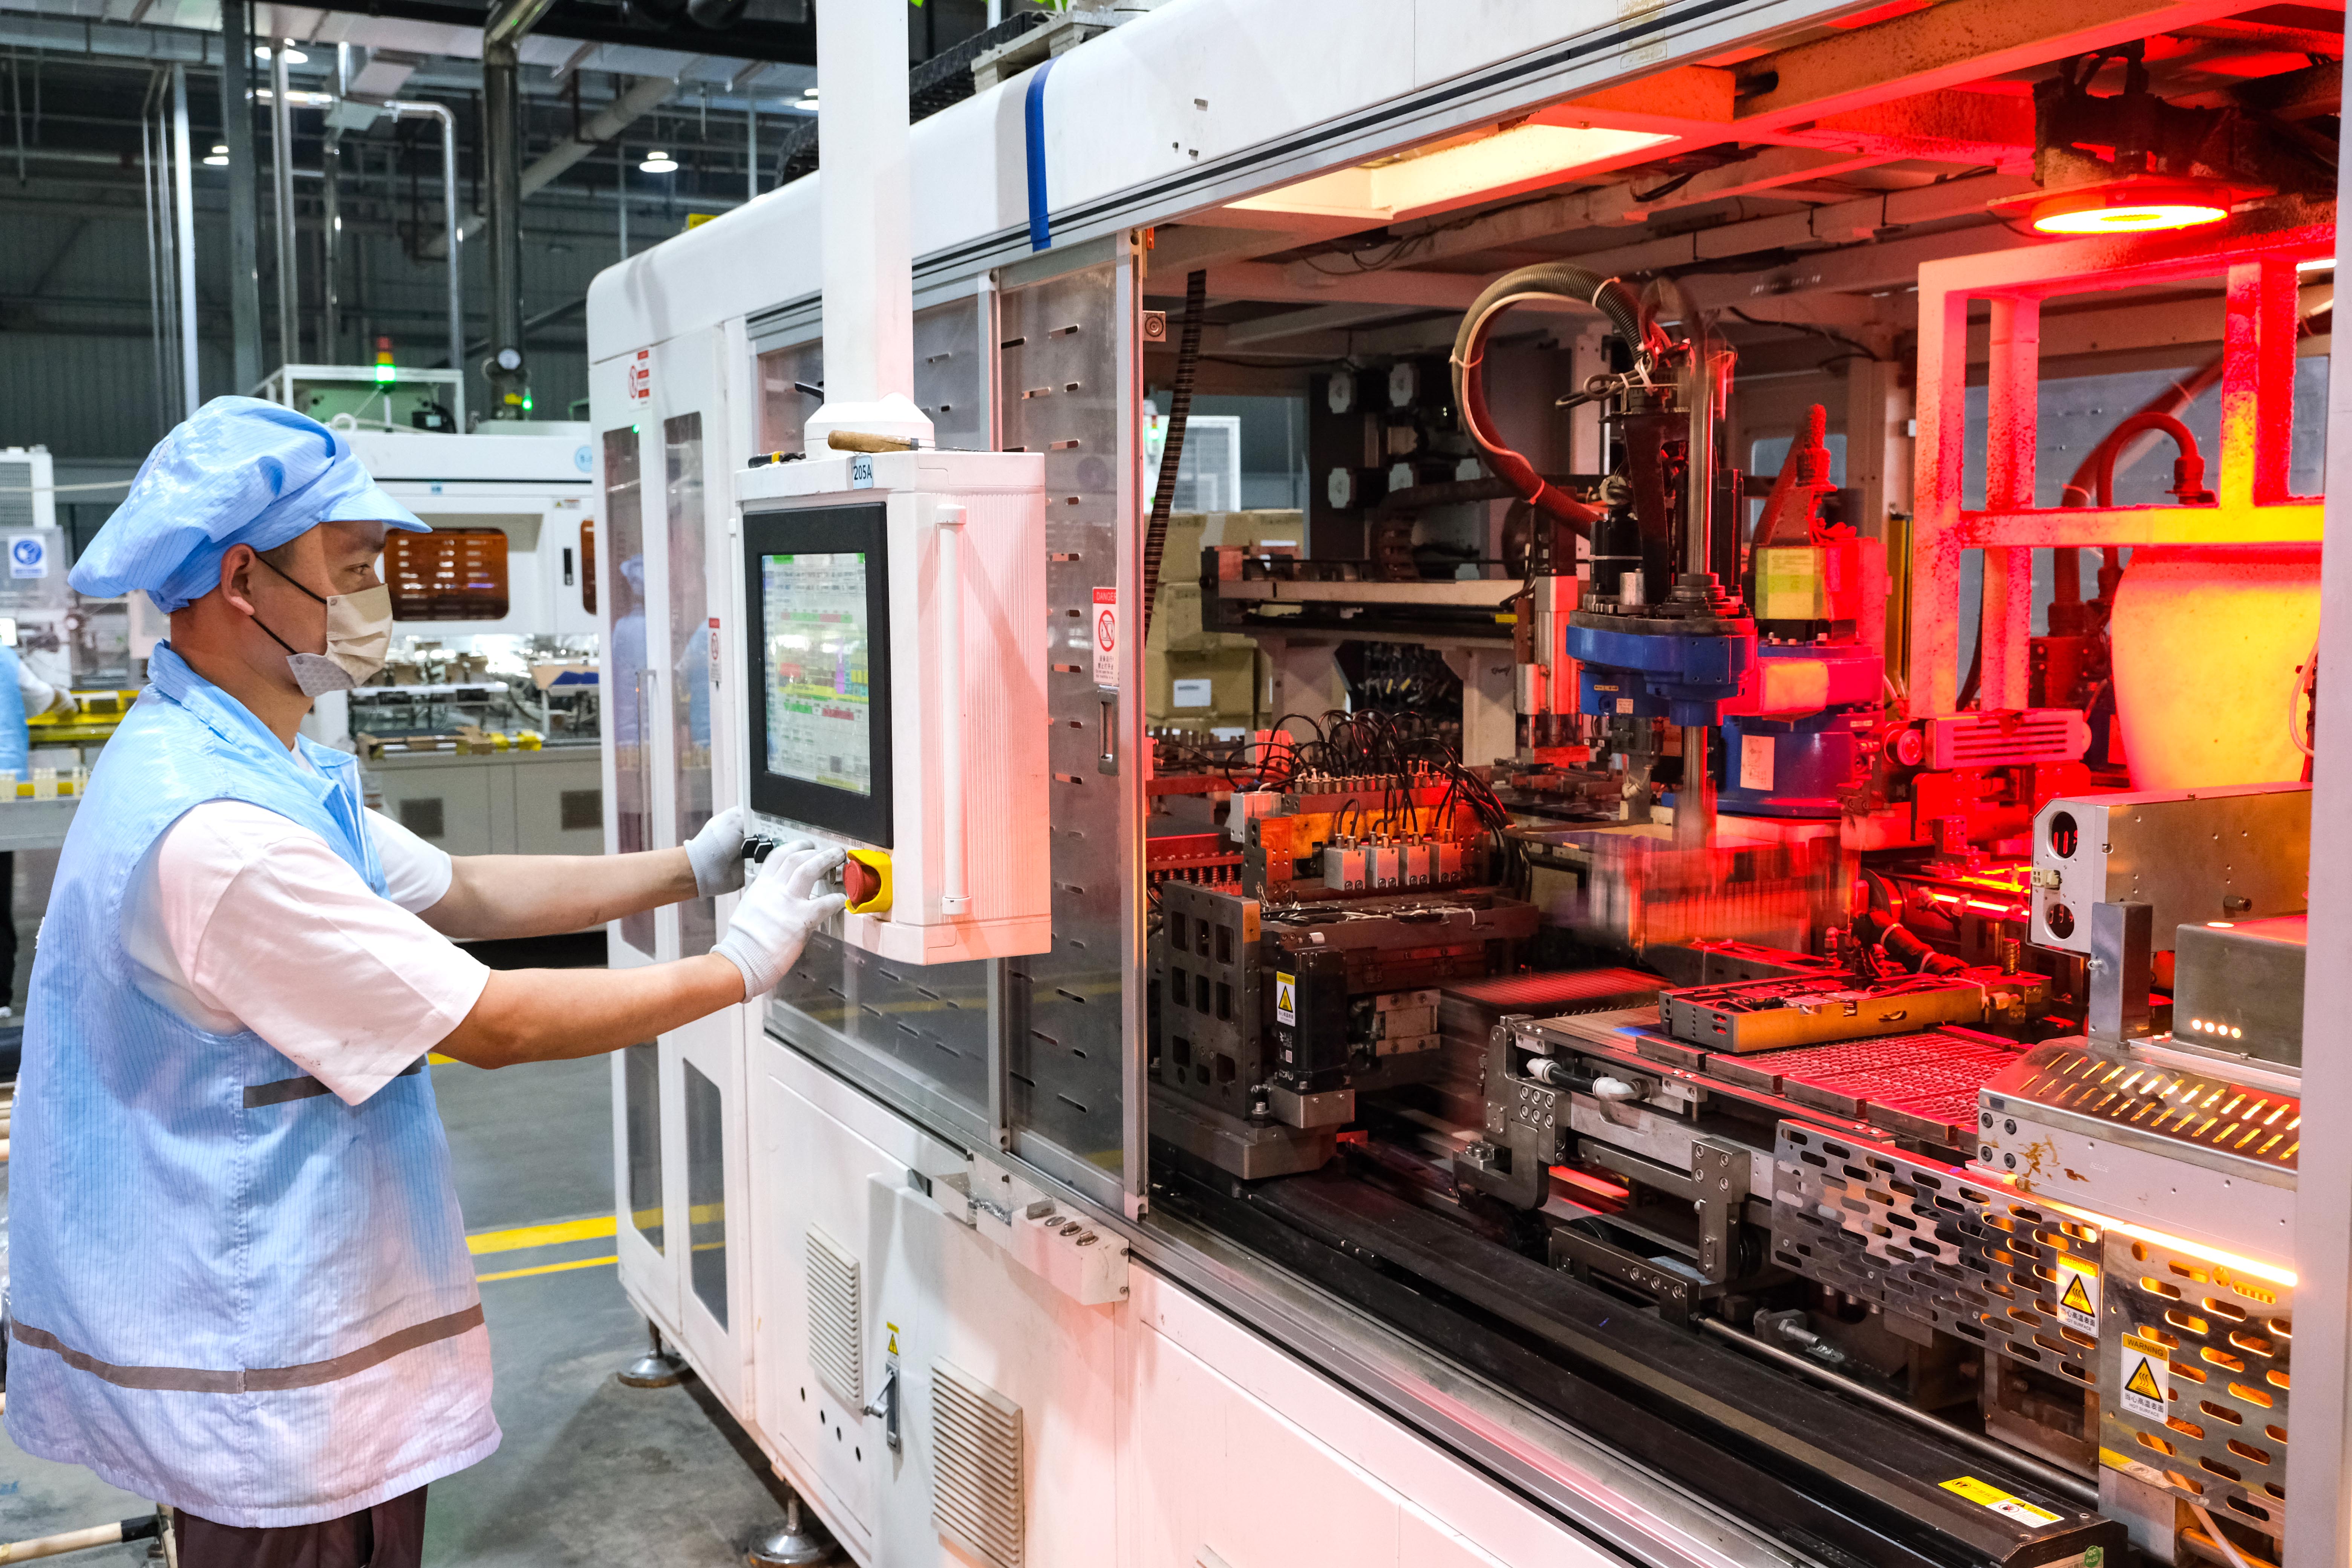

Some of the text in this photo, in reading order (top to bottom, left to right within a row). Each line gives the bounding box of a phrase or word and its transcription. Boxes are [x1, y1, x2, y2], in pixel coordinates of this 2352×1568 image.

[853, 464, 872, 480] 205A
[2062, 1256, 2094, 1272] WARNING
[2061, 1307, 2095, 1326] 当心高温表面
[2128, 1338, 2164, 1357] WARNING
[2125, 1392, 2164, 1413] 当心高温表面
[2139, 1406, 2160, 1418] SURFACE
[2028, 1507, 2055, 1520] CAUTION
